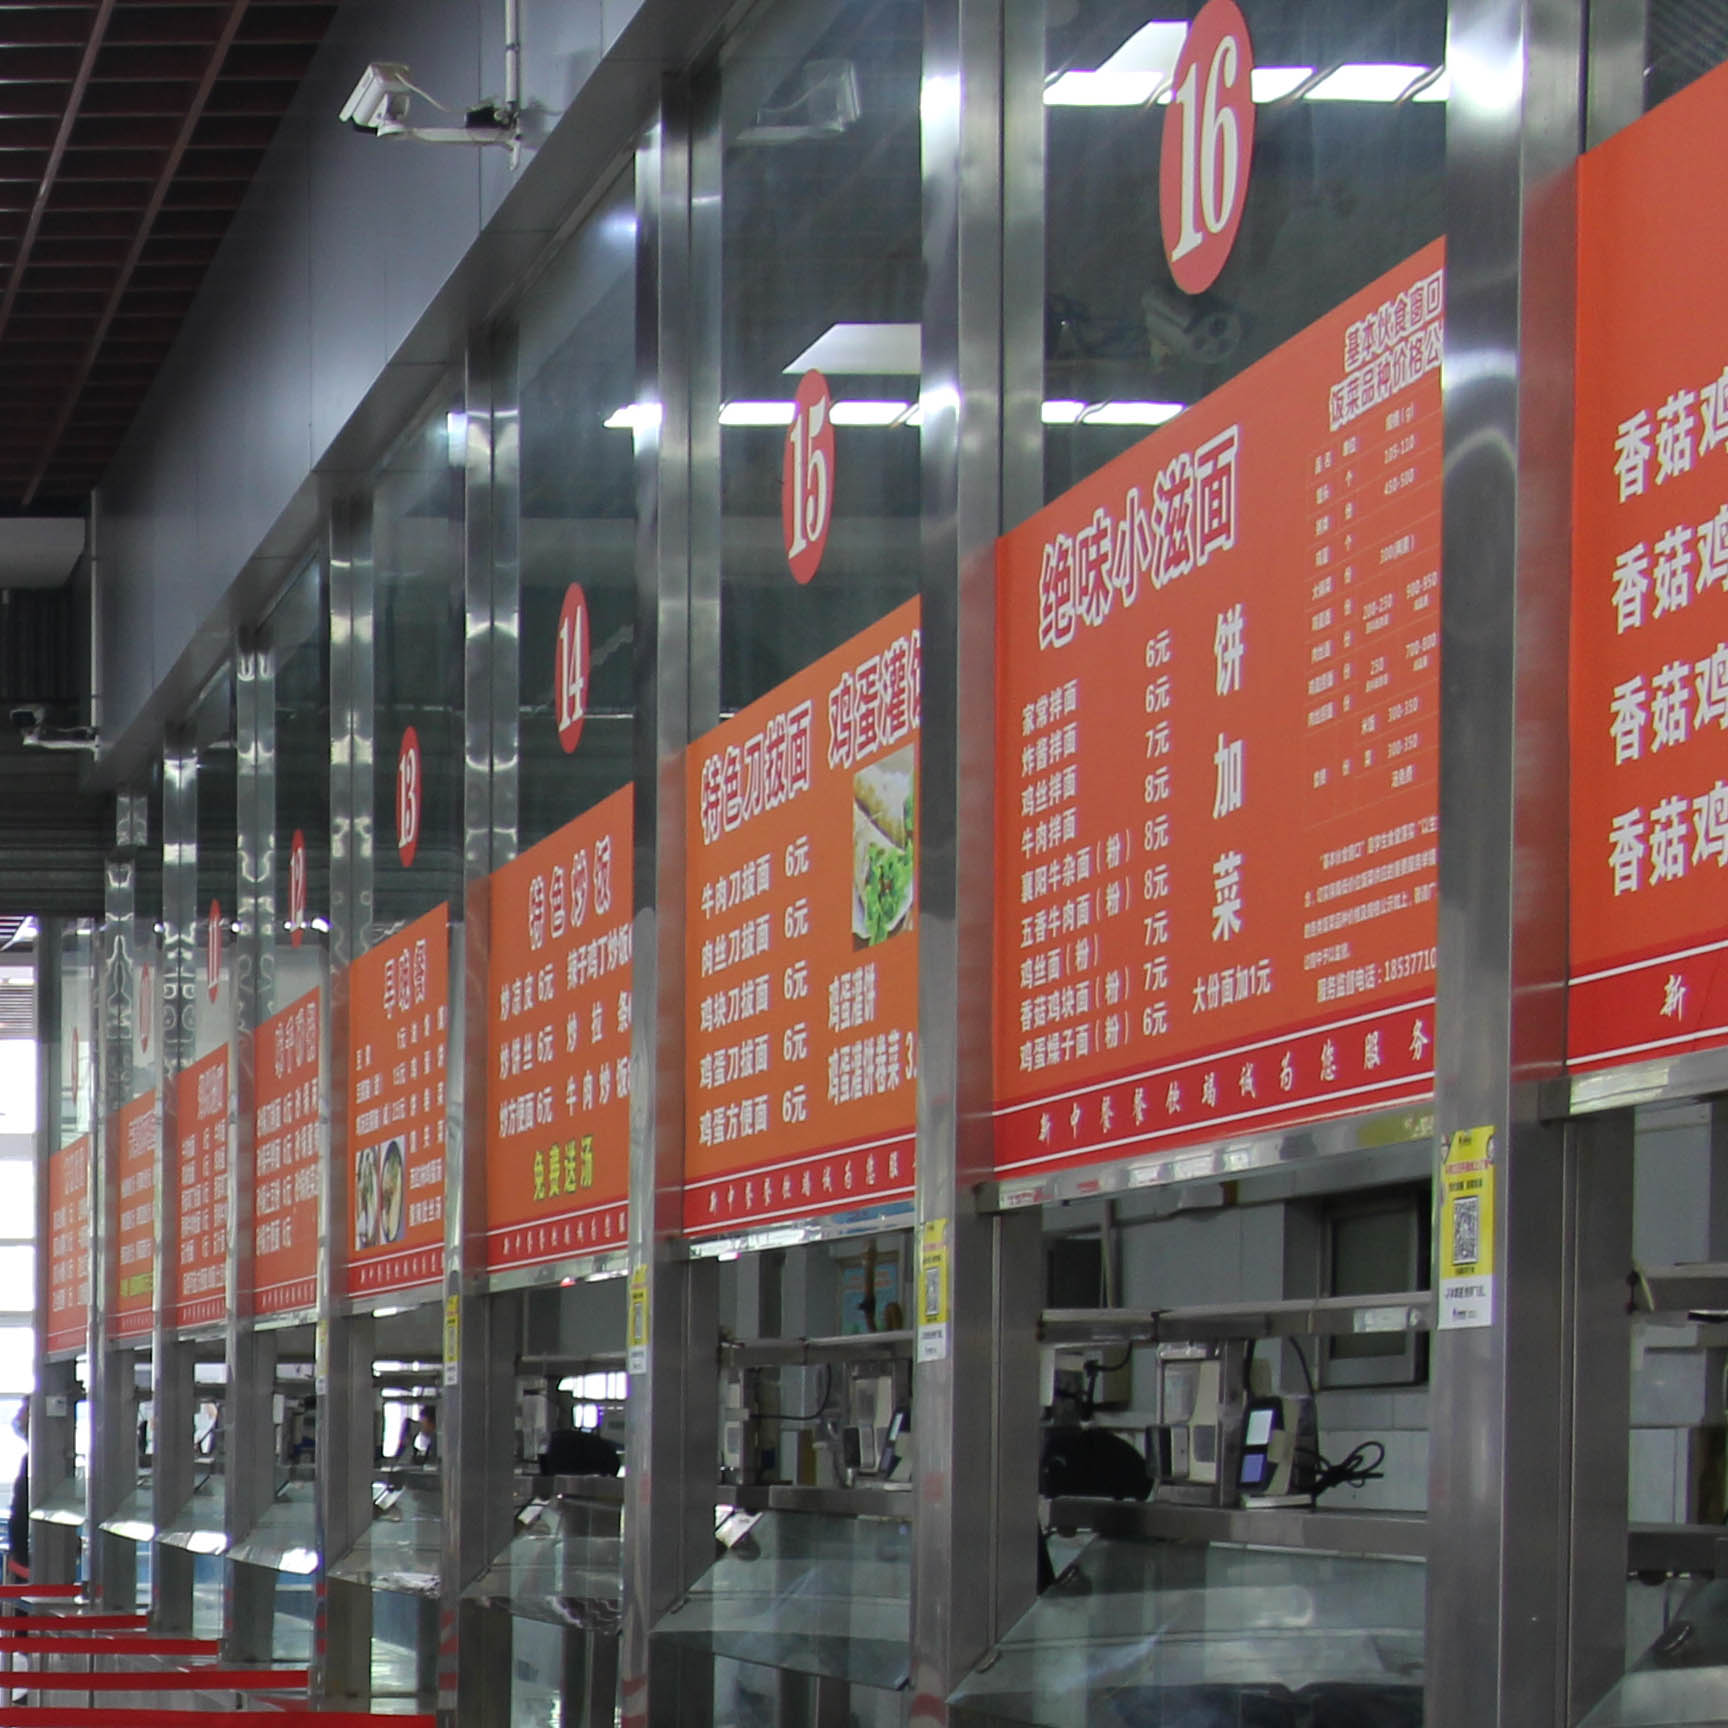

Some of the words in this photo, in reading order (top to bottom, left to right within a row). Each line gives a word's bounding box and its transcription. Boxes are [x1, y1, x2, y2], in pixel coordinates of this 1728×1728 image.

[1170, 24, 1240, 263] 16
[1344, 268, 1443, 373] 基本伙食窗口
[788, 394, 829, 559] 15
[1039, 423, 1239, 651] 绝味小滋面
[557, 608, 583, 730] 14
[1021, 679, 1077, 736] 家常拌面
[1146, 630, 1171, 667] 6元
[1021, 722, 1077, 778] 炸酱拌面
[1146, 675, 1170, 712] 6元
[397, 746, 417, 848] 13
[1021, 764, 1077, 817] 鸡丝拌面
[1145, 721, 1170, 758] 7元
[1021, 807, 1076, 860] 牛肉拌面
[1144, 766, 1169, 803] 8元
[1144, 814, 1169, 850] 8元
[785, 835, 809, 878] 6元
[1144, 864, 1169, 900] 8元
[290, 846, 305, 928] 12
[784, 897, 809, 939] 6元
[1144, 910, 1168, 946] 7元
[208, 910, 220, 989] 11
[784, 959, 808, 1000] 6元
[1144, 956, 1168, 991] 7元
[538, 962, 554, 1002] 6元
[1193, 958, 1272, 1015] 大份面加1元
[1659, 973, 1687, 1024] 新
[537, 1025, 554, 1062] 6元
[783, 1022, 807, 1062] 6元
[1143, 1002, 1168, 1036] 6元
[537, 1086, 553, 1125] 6元
[699, 1094, 769, 1148] 鸡蛋方便面
[782, 1084, 807, 1124] 6元
[533, 1134, 593, 1200] 免费送汤
